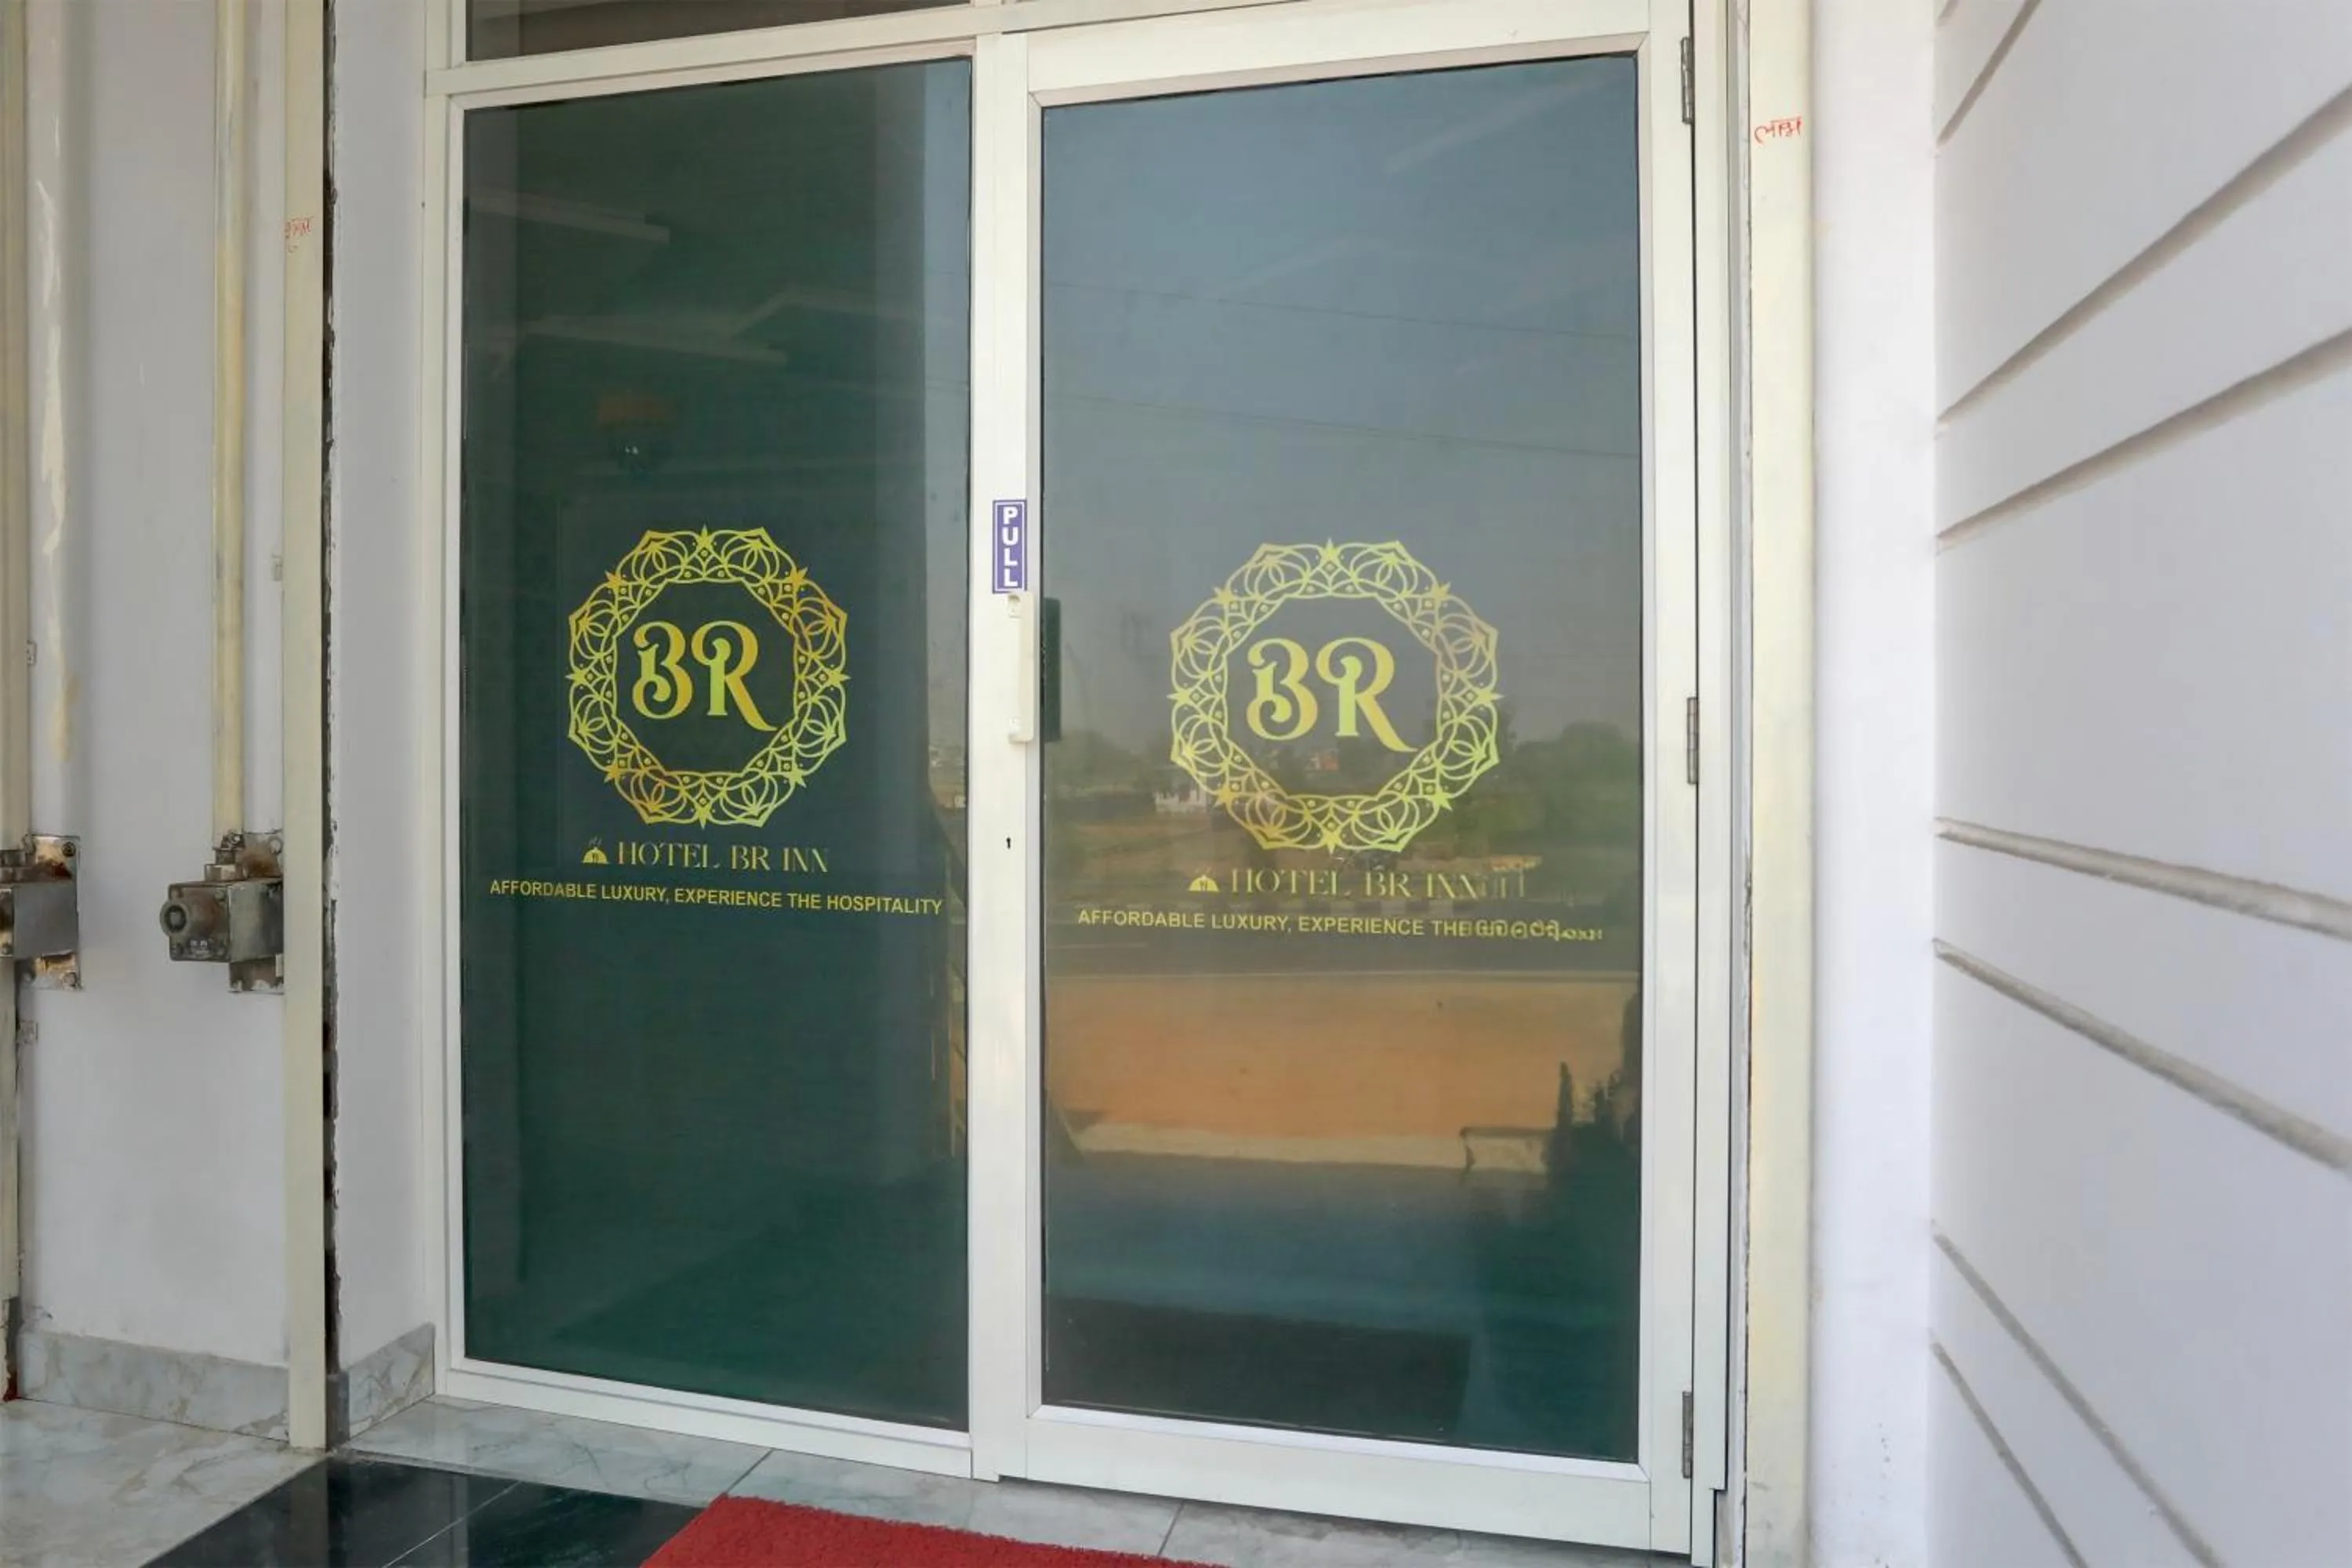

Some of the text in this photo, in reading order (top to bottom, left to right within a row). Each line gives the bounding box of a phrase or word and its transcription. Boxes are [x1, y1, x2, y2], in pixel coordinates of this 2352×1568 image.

[1002, 506, 1019, 587] PULL
[632, 620, 780, 732] BR
[1246, 637, 1418, 753] BR
[617, 841, 829, 873] HOTEL BR INN
[490, 879, 942, 916] AFFORDABLE LUXURY, EXPERIENCE THE HOSPITALITY
[1232, 868, 1351, 896] HOTEL
[1366, 871, 1412, 898] BR
[1078, 909, 1206, 928] AFFORDABLE
[1211, 914, 1293, 933] LUXURY,
[1298, 916, 1425, 936] EXPERIENCE
